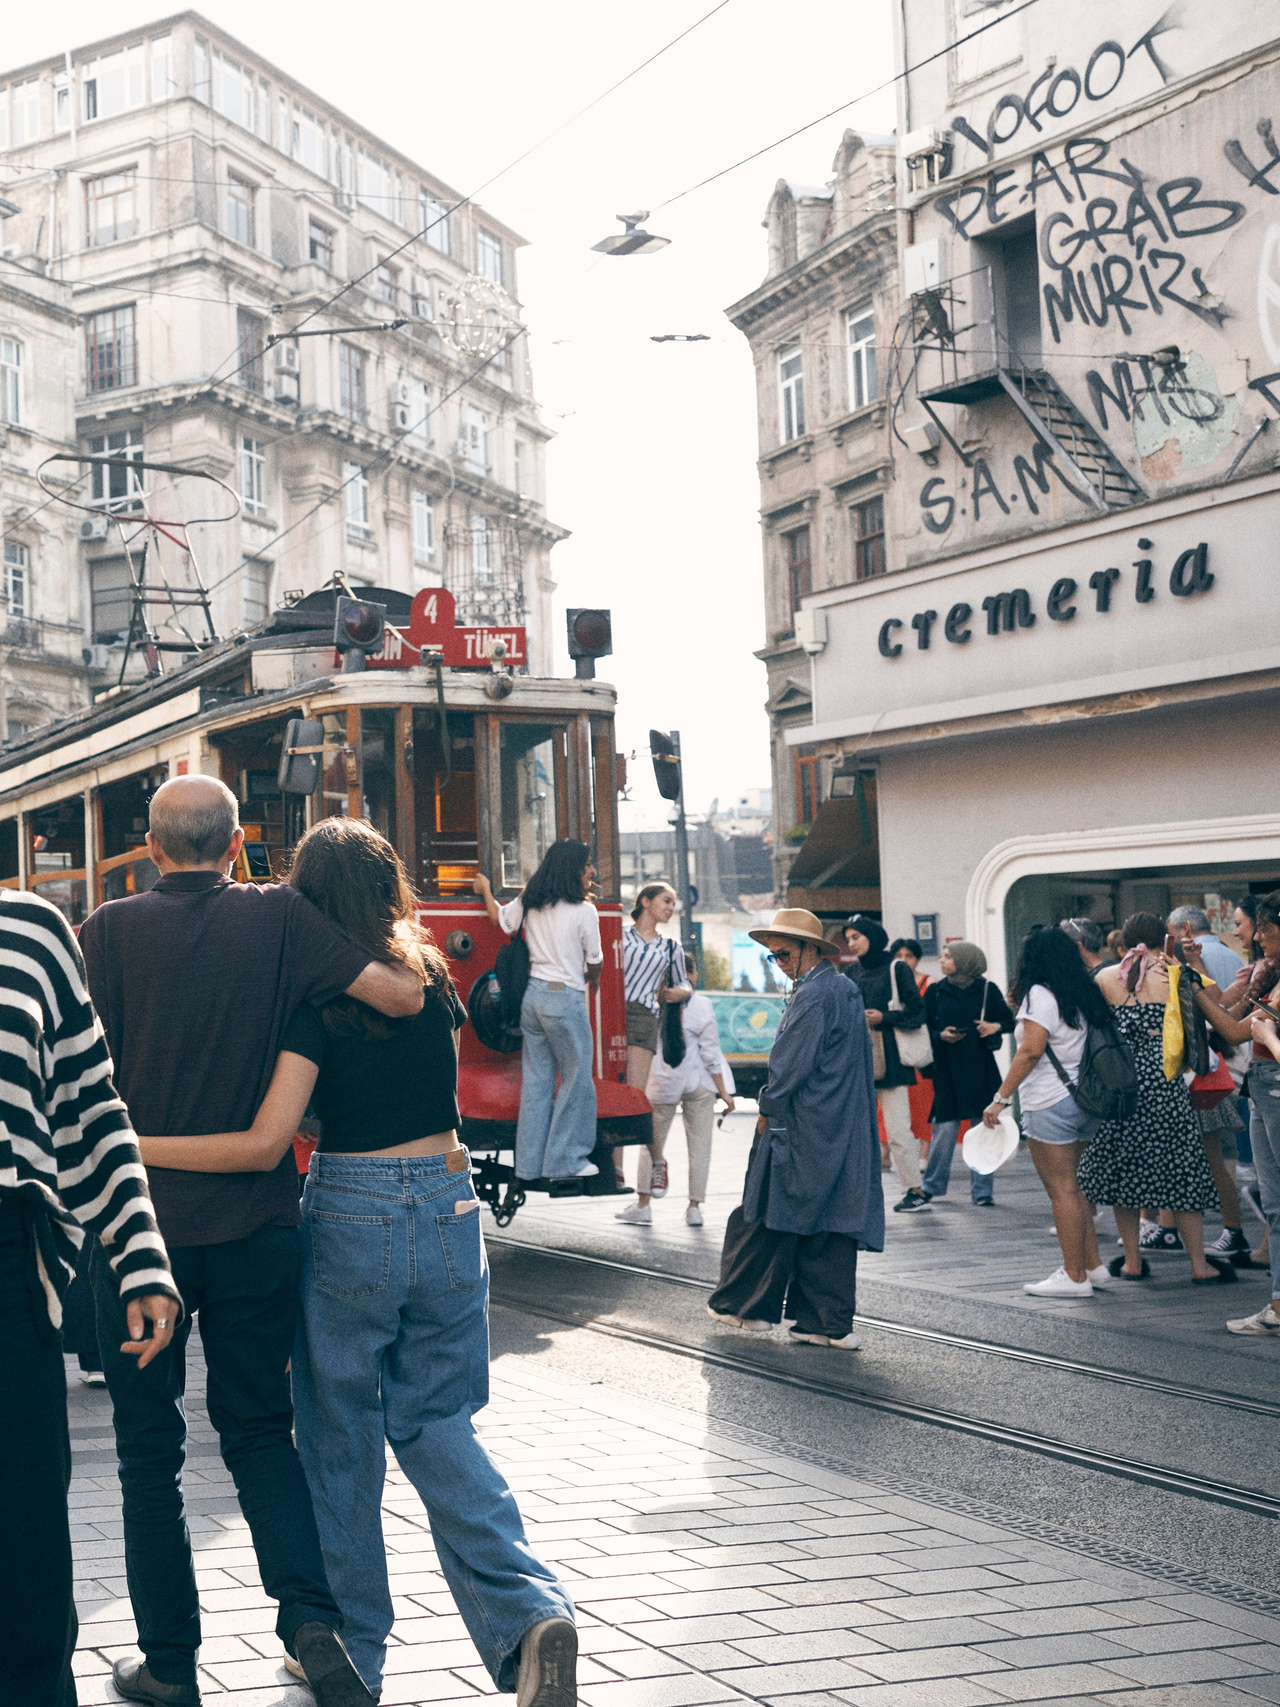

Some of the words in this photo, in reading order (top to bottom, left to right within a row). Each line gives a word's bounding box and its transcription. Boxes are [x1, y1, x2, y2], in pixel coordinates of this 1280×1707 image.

[423, 594, 438, 624] 4
[878, 538, 1216, 659] cremeria
[464, 630, 523, 659] TÜEL
